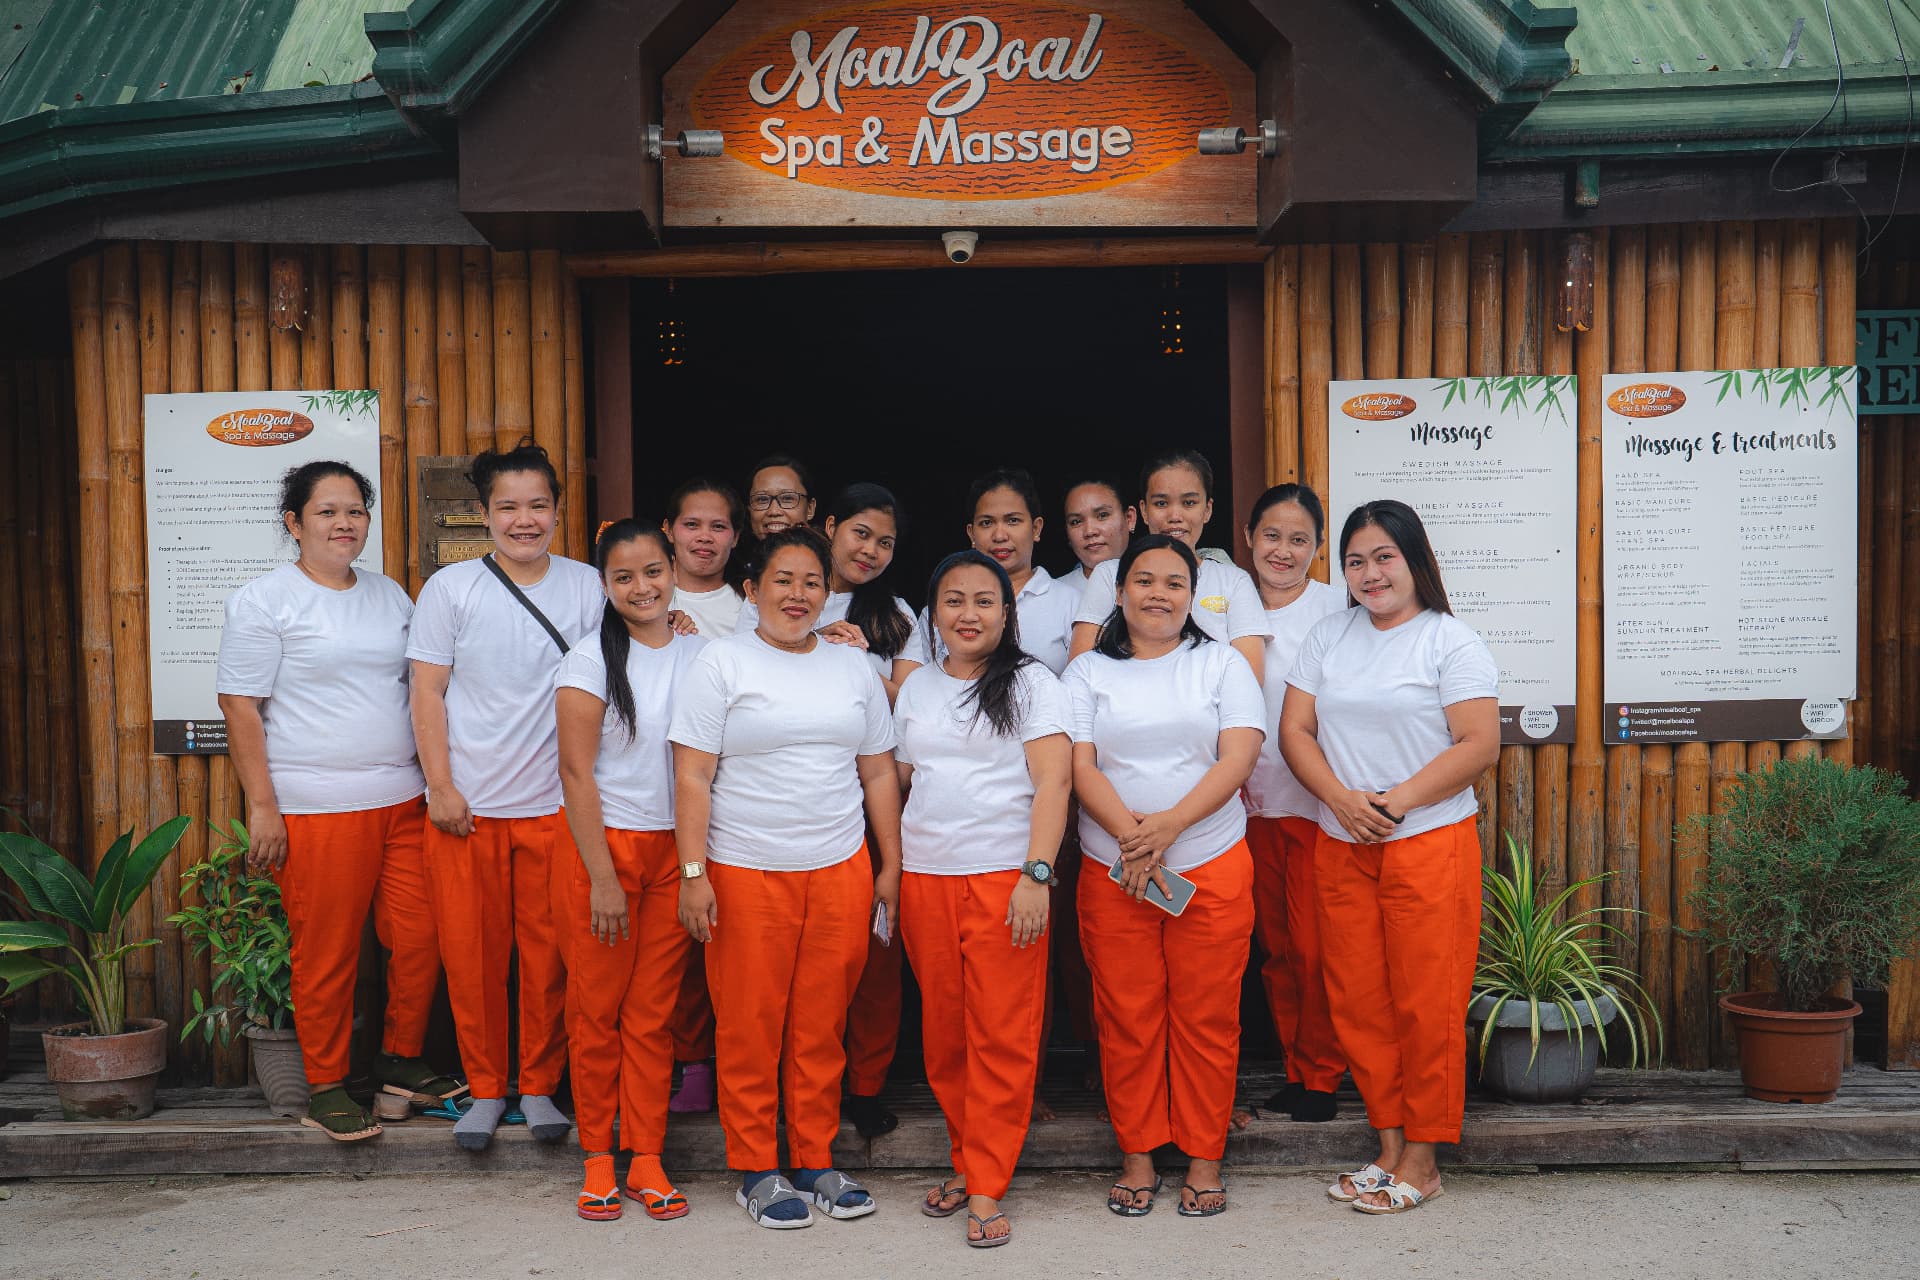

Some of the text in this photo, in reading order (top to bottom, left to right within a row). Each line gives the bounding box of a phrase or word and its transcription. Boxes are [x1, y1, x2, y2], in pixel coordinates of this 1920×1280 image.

[748, 13, 1104, 117] MoalBoal
[759, 116, 1133, 178] Spa & Massage
[1642, 404, 1672, 412] Massage
[222, 412, 295, 433] MoalBoal
[224, 432, 295, 441] Spa & Massage
[1410, 421, 1495, 450] Massage
[1625, 428, 1837, 462] Massage & treatments
[1402, 459, 1503, 468] SWEDISH MASSAGE
